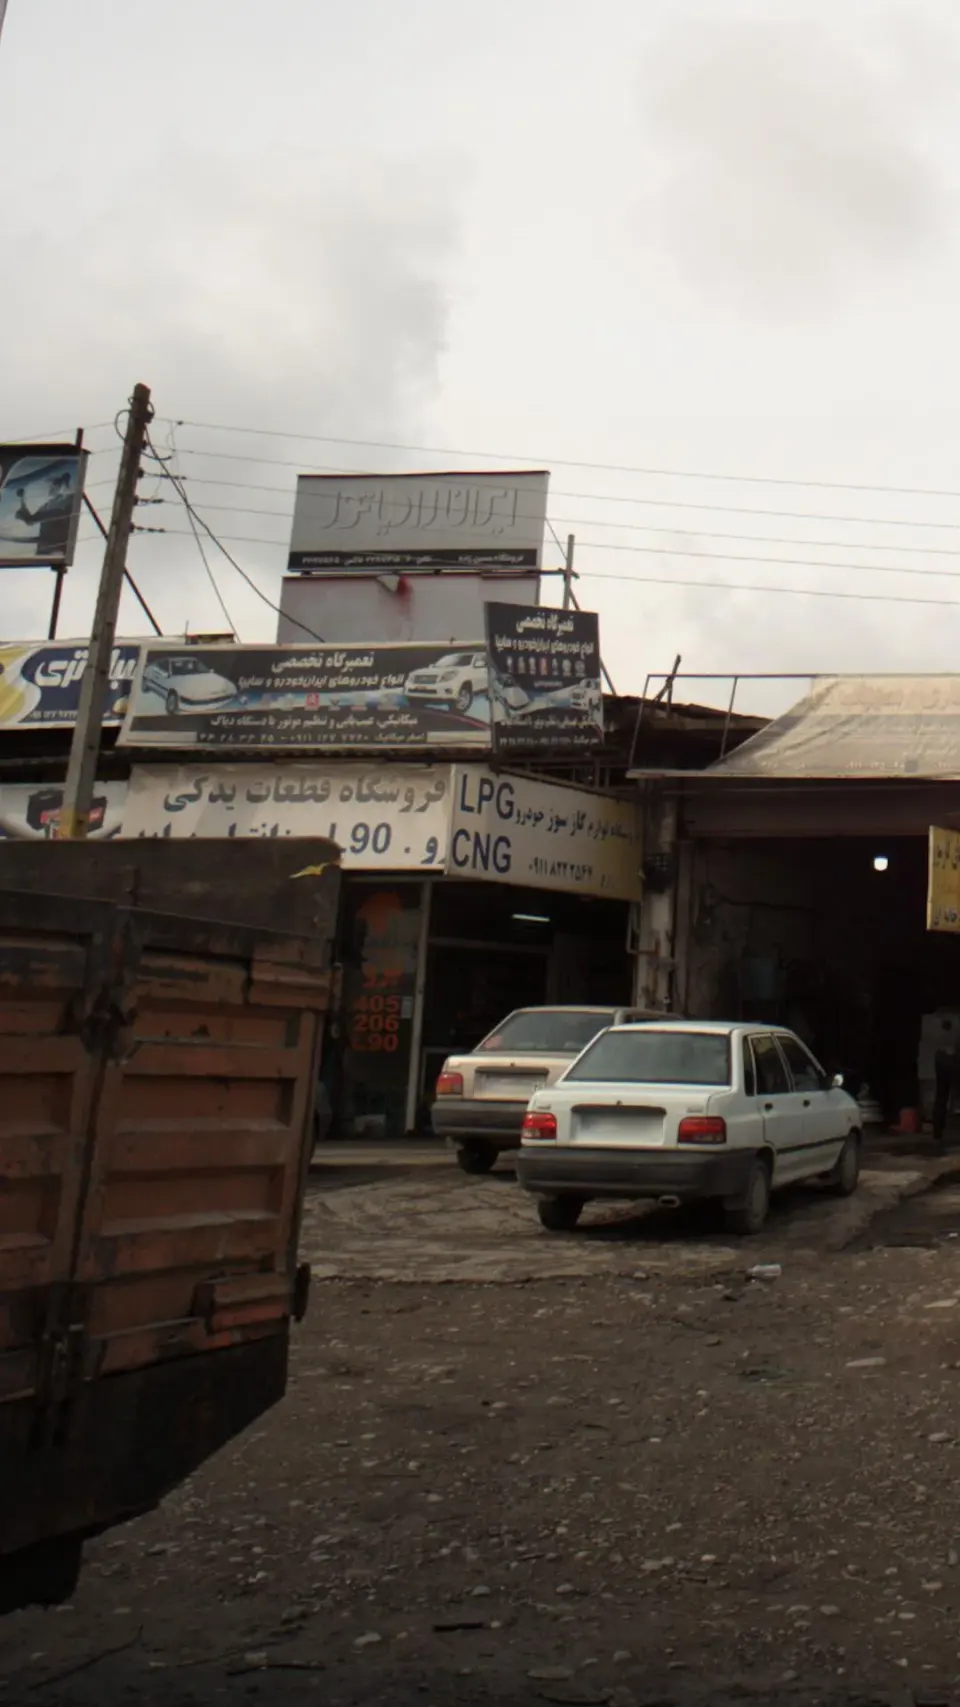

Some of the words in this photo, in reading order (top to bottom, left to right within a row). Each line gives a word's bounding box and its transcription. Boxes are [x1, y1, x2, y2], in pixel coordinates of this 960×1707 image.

[271, 652, 324, 674] تخصصی
[325, 651, 375, 673] تعمیرگاه
[163, 776, 238, 812] یدکی
[246, 776, 331, 804] قطعات
[339, 776, 446, 813] فروشگاه
[460, 773, 515, 820] LPG
[452, 828, 512, 873] CNG
[353, 1014, 400, 1033] 206
